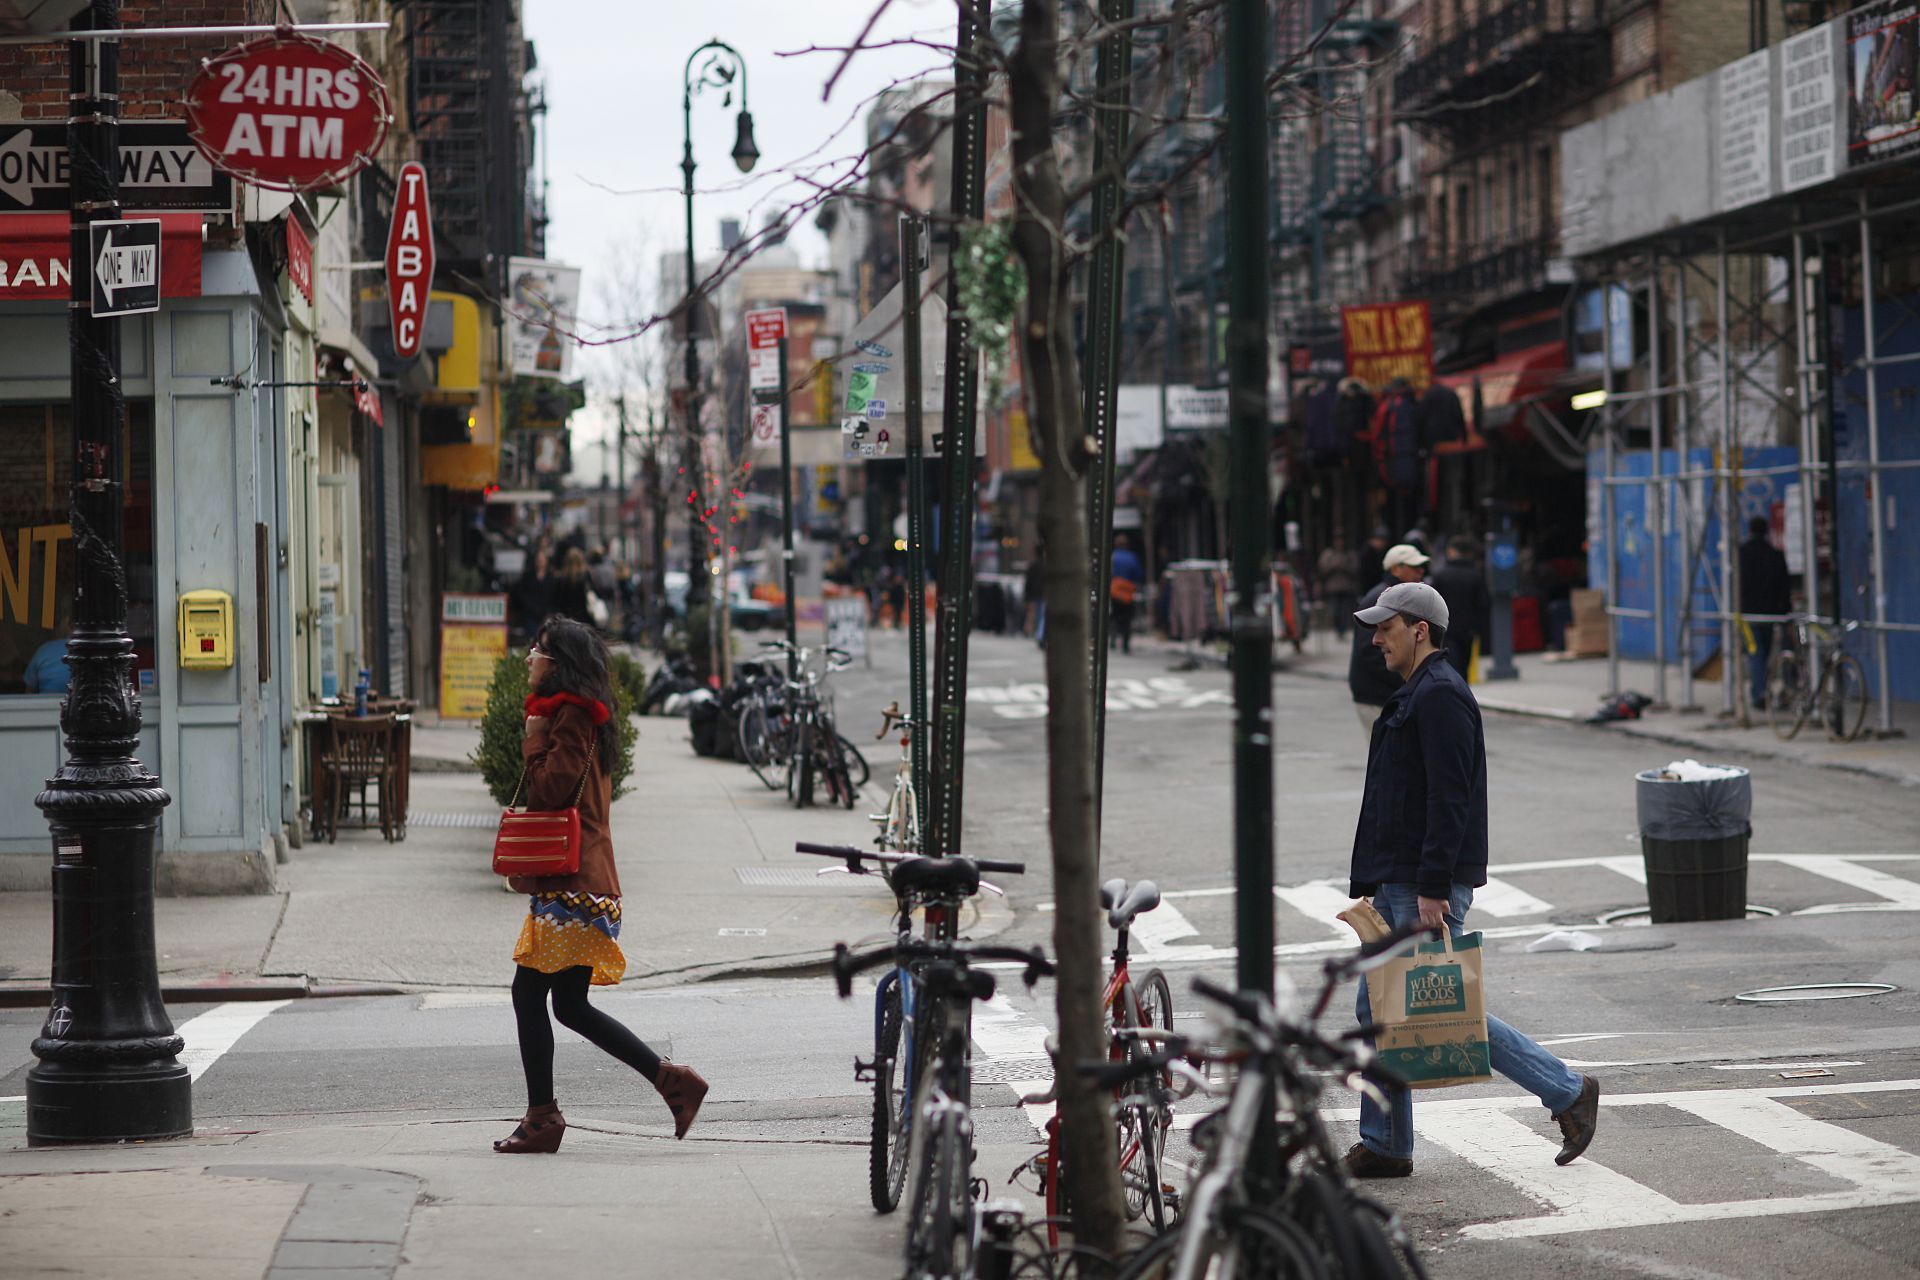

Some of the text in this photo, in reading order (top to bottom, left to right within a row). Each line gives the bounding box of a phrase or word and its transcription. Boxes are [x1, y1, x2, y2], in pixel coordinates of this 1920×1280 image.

[223, 113, 344, 160] ATM
[1, 150, 196, 184] ONE WAY
[103, 249, 152, 285] ONE WAY
[397, 173, 423, 350] TABAC
[1410, 975, 1456, 991] WHOLE
[1412, 986, 1456, 1001] FOODS
[1392, 1019, 1481, 1032] WHOLEFOODSMARKET.COM
